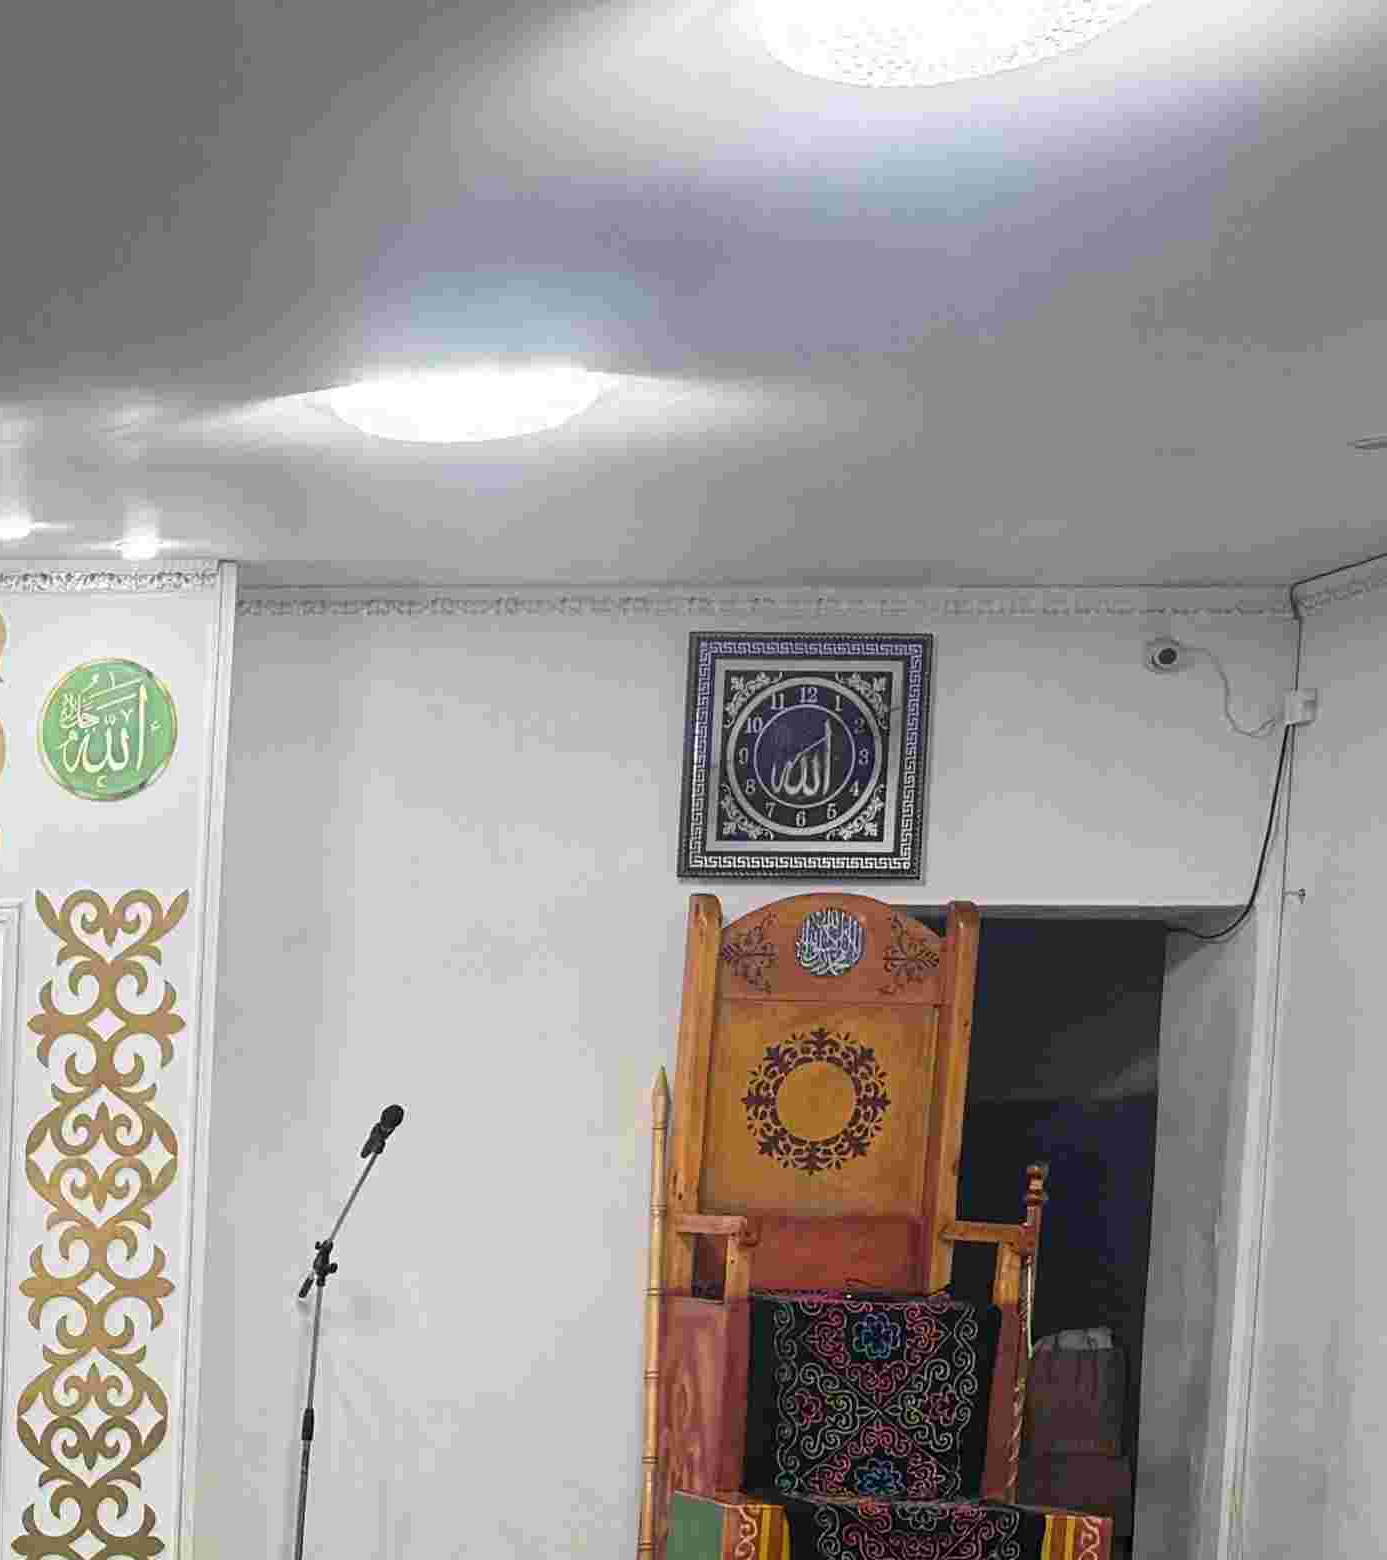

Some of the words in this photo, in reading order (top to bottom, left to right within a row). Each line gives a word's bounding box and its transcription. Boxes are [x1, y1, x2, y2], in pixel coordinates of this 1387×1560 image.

[771, 693, 785, 710] 11
[799, 687, 819, 703] 12
[835, 695, 843, 711] 1
[746, 717, 764, 733] 10
[795, 811, 807, 827] 6
